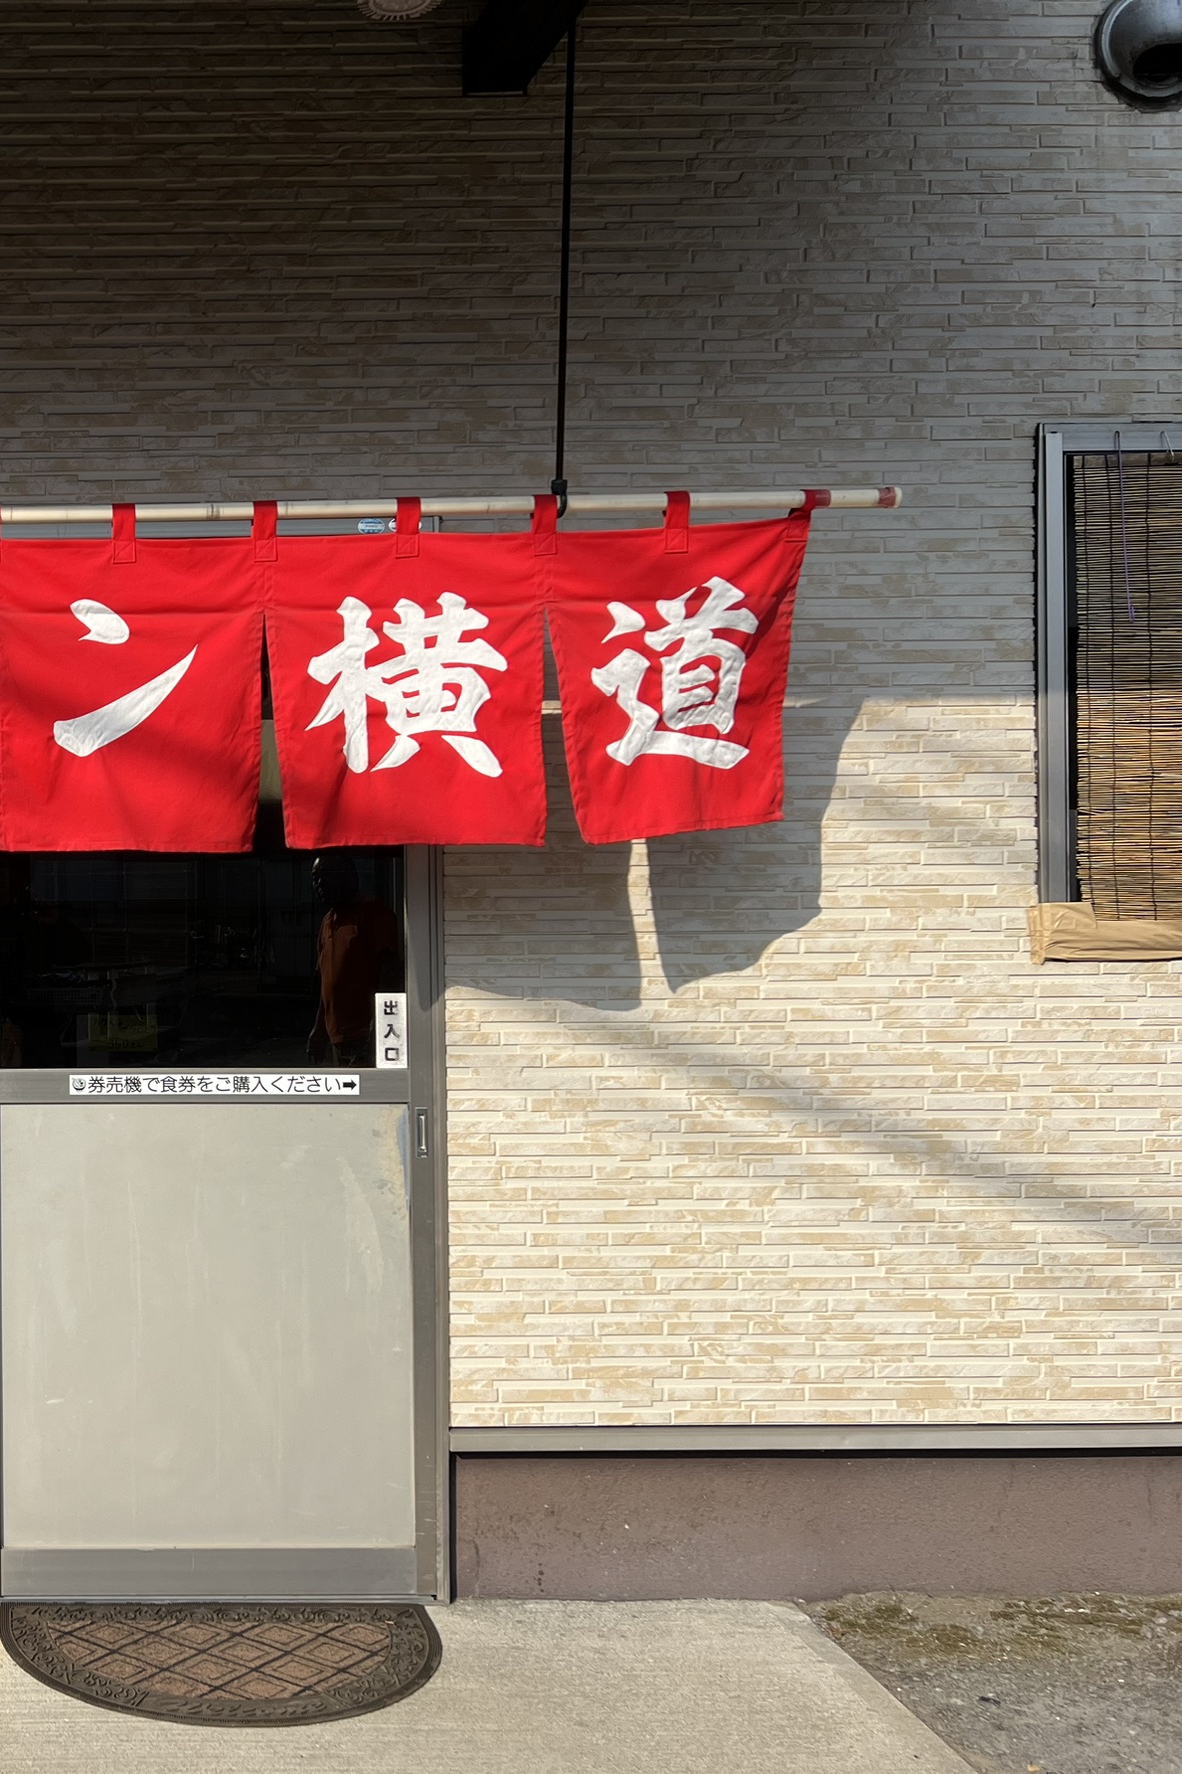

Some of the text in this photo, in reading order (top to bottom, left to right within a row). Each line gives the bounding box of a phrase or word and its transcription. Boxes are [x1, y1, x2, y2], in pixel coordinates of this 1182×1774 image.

[384, 1000, 400, 1061] 出入口
[88, 1075, 341, 1094] 券売機で食券をご購入ください
